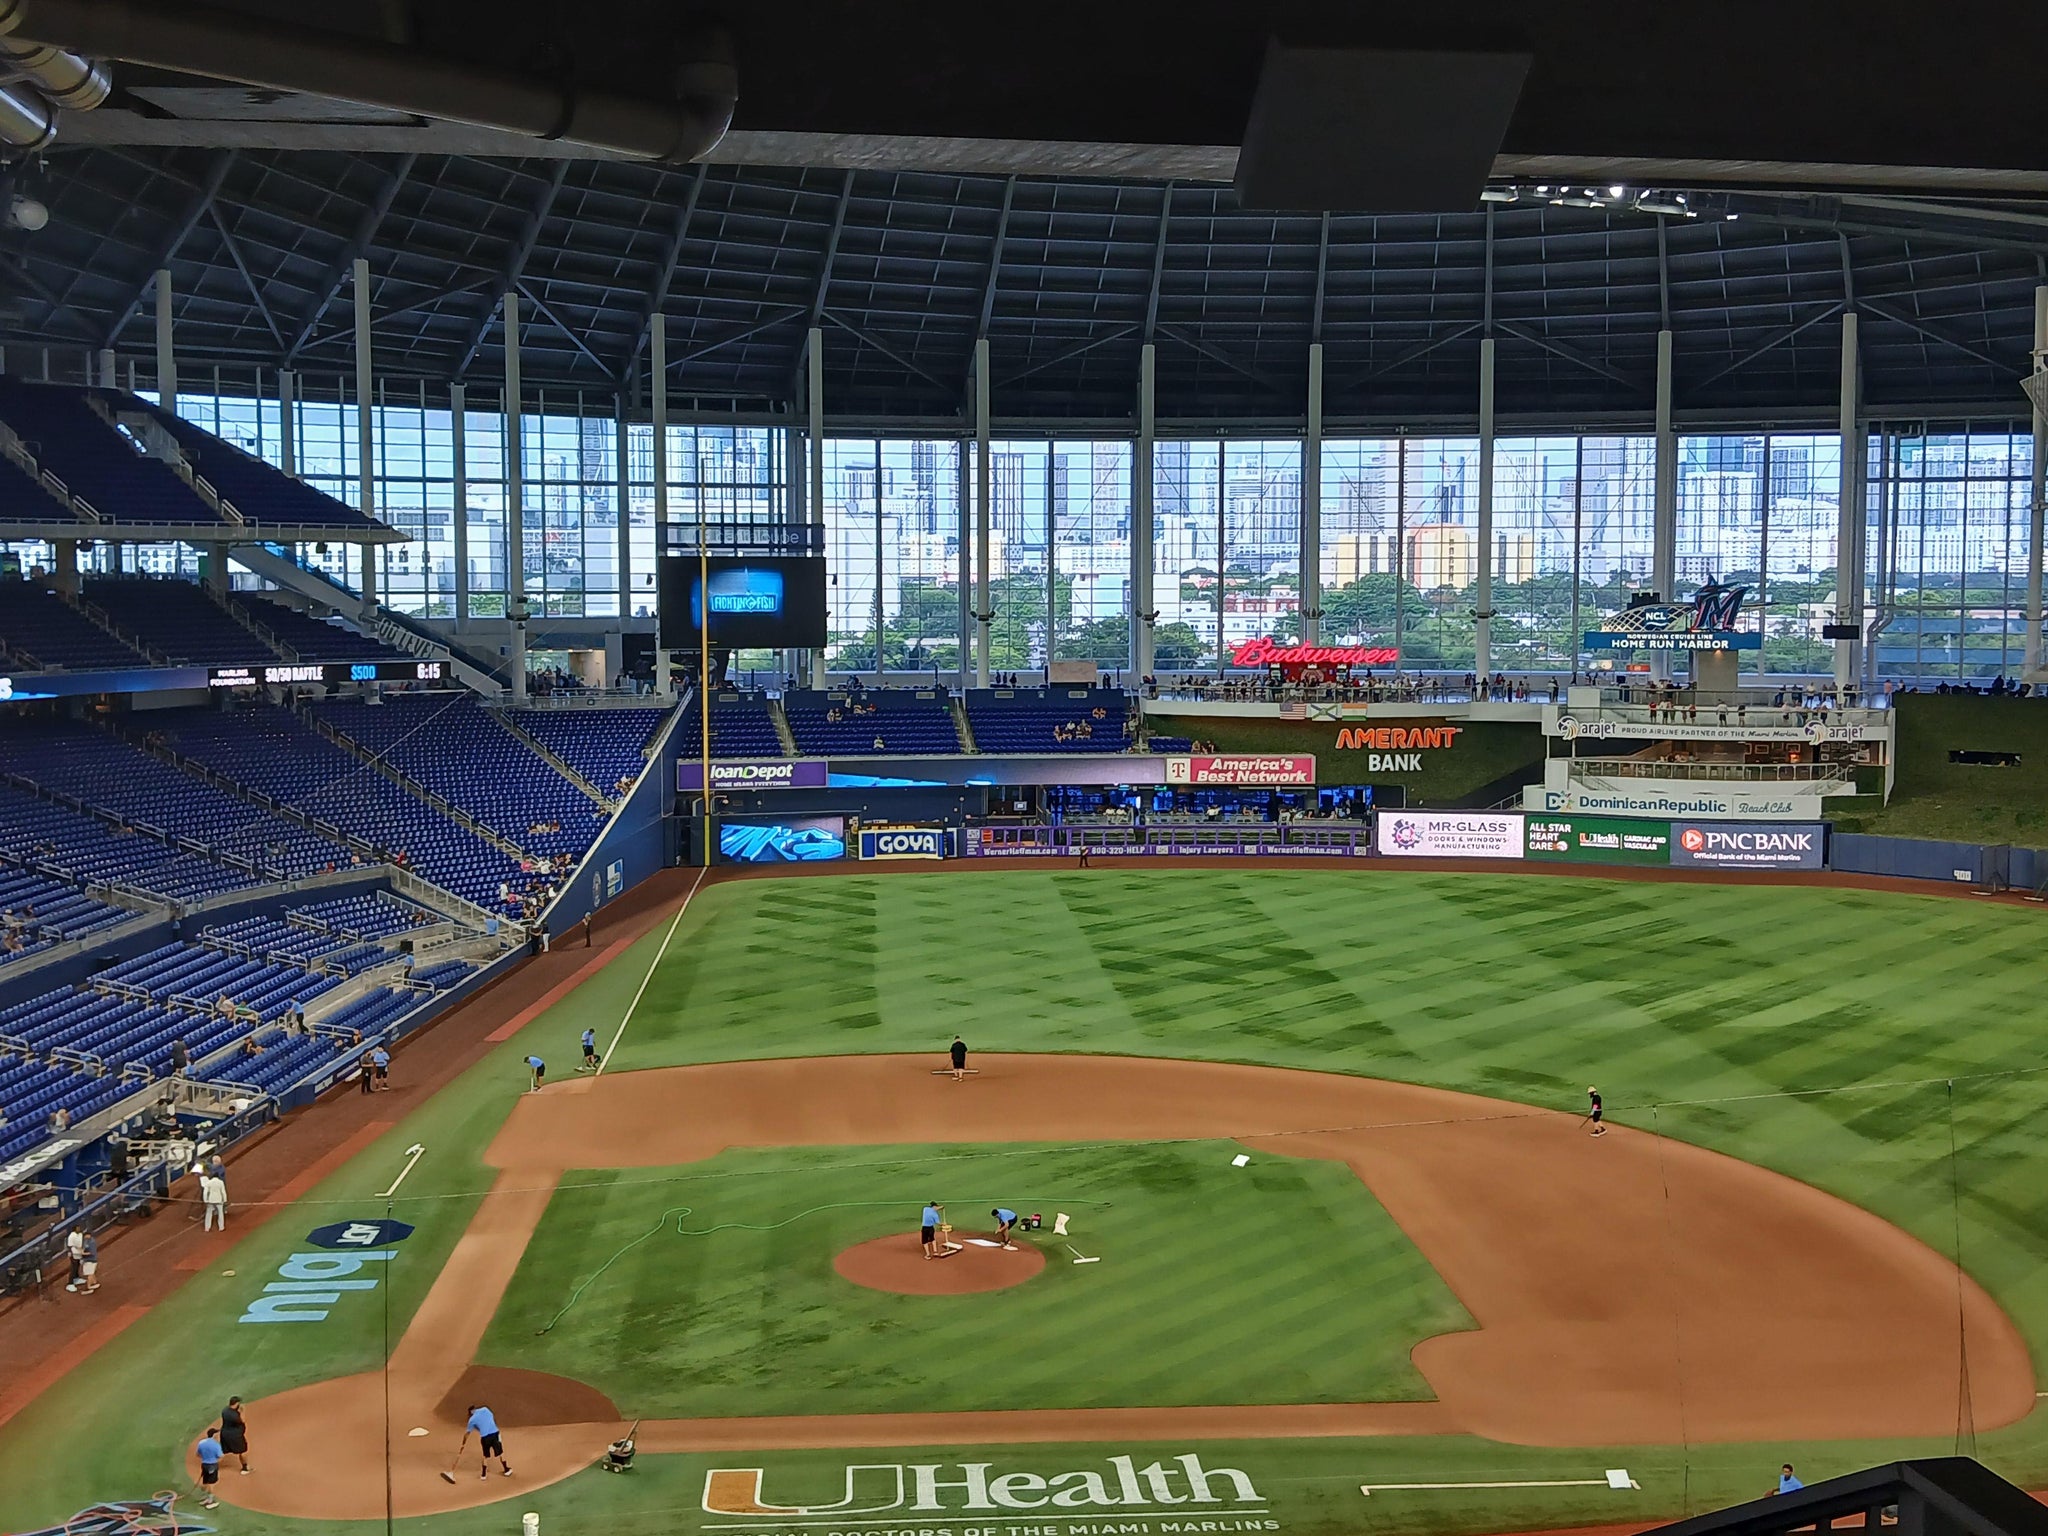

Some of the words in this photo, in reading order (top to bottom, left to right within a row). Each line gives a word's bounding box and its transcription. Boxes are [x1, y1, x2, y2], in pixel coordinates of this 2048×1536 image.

[1645, 612, 1667, 621] NCL
[1611, 640, 1645, 649] HOME
[1649, 640, 1675, 649] RUN
[1678, 640, 1729, 649] HARBOR
[1229, 637, 1399, 666] Budweiser
[265, 667, 292, 682] 50/50
[292, 666, 324, 681] RAFFLE
[350, 665, 376, 680] $500
[417, 663, 441, 679] 6:15
[210, 677, 256, 686] FOUNDATION
[1581, 720, 1616, 738] arajet
[1681, 729, 1716, 737] PARTNER
[1829, 724, 1864, 742] arajet
[1335, 728, 1459, 749] AMERANT
[1210, 758, 1293, 770] America's
[1368, 754, 1422, 771] BANK
[710, 765, 794, 780] loanDepot
[1197, 770, 1234, 782] Best
[1236, 770, 1307, 782] Network
[1738, 801, 1768, 813] Beach
[1770, 801, 1792, 813] Club
[1529, 822, 1546, 832] ALL
[1548, 824, 1571, 833] STAR
[1529, 832, 1559, 841] HEART
[1652, 836, 1667, 844] AND
[879, 835, 936, 853] GOYA
[1529, 841, 1553, 850] CARE
[1624, 842, 1657, 850] VASCULAR
[1203, 846, 1234, 855] Lawyers
[336, 1223, 381, 1245] ADT
[964, 1527, 996, 1536] OF
[1005, 1525, 1058, 1536] THE
[1069, 1523, 1149, 1535] MIAMI
[1161, 1519, 1280, 1532] MARLINS
